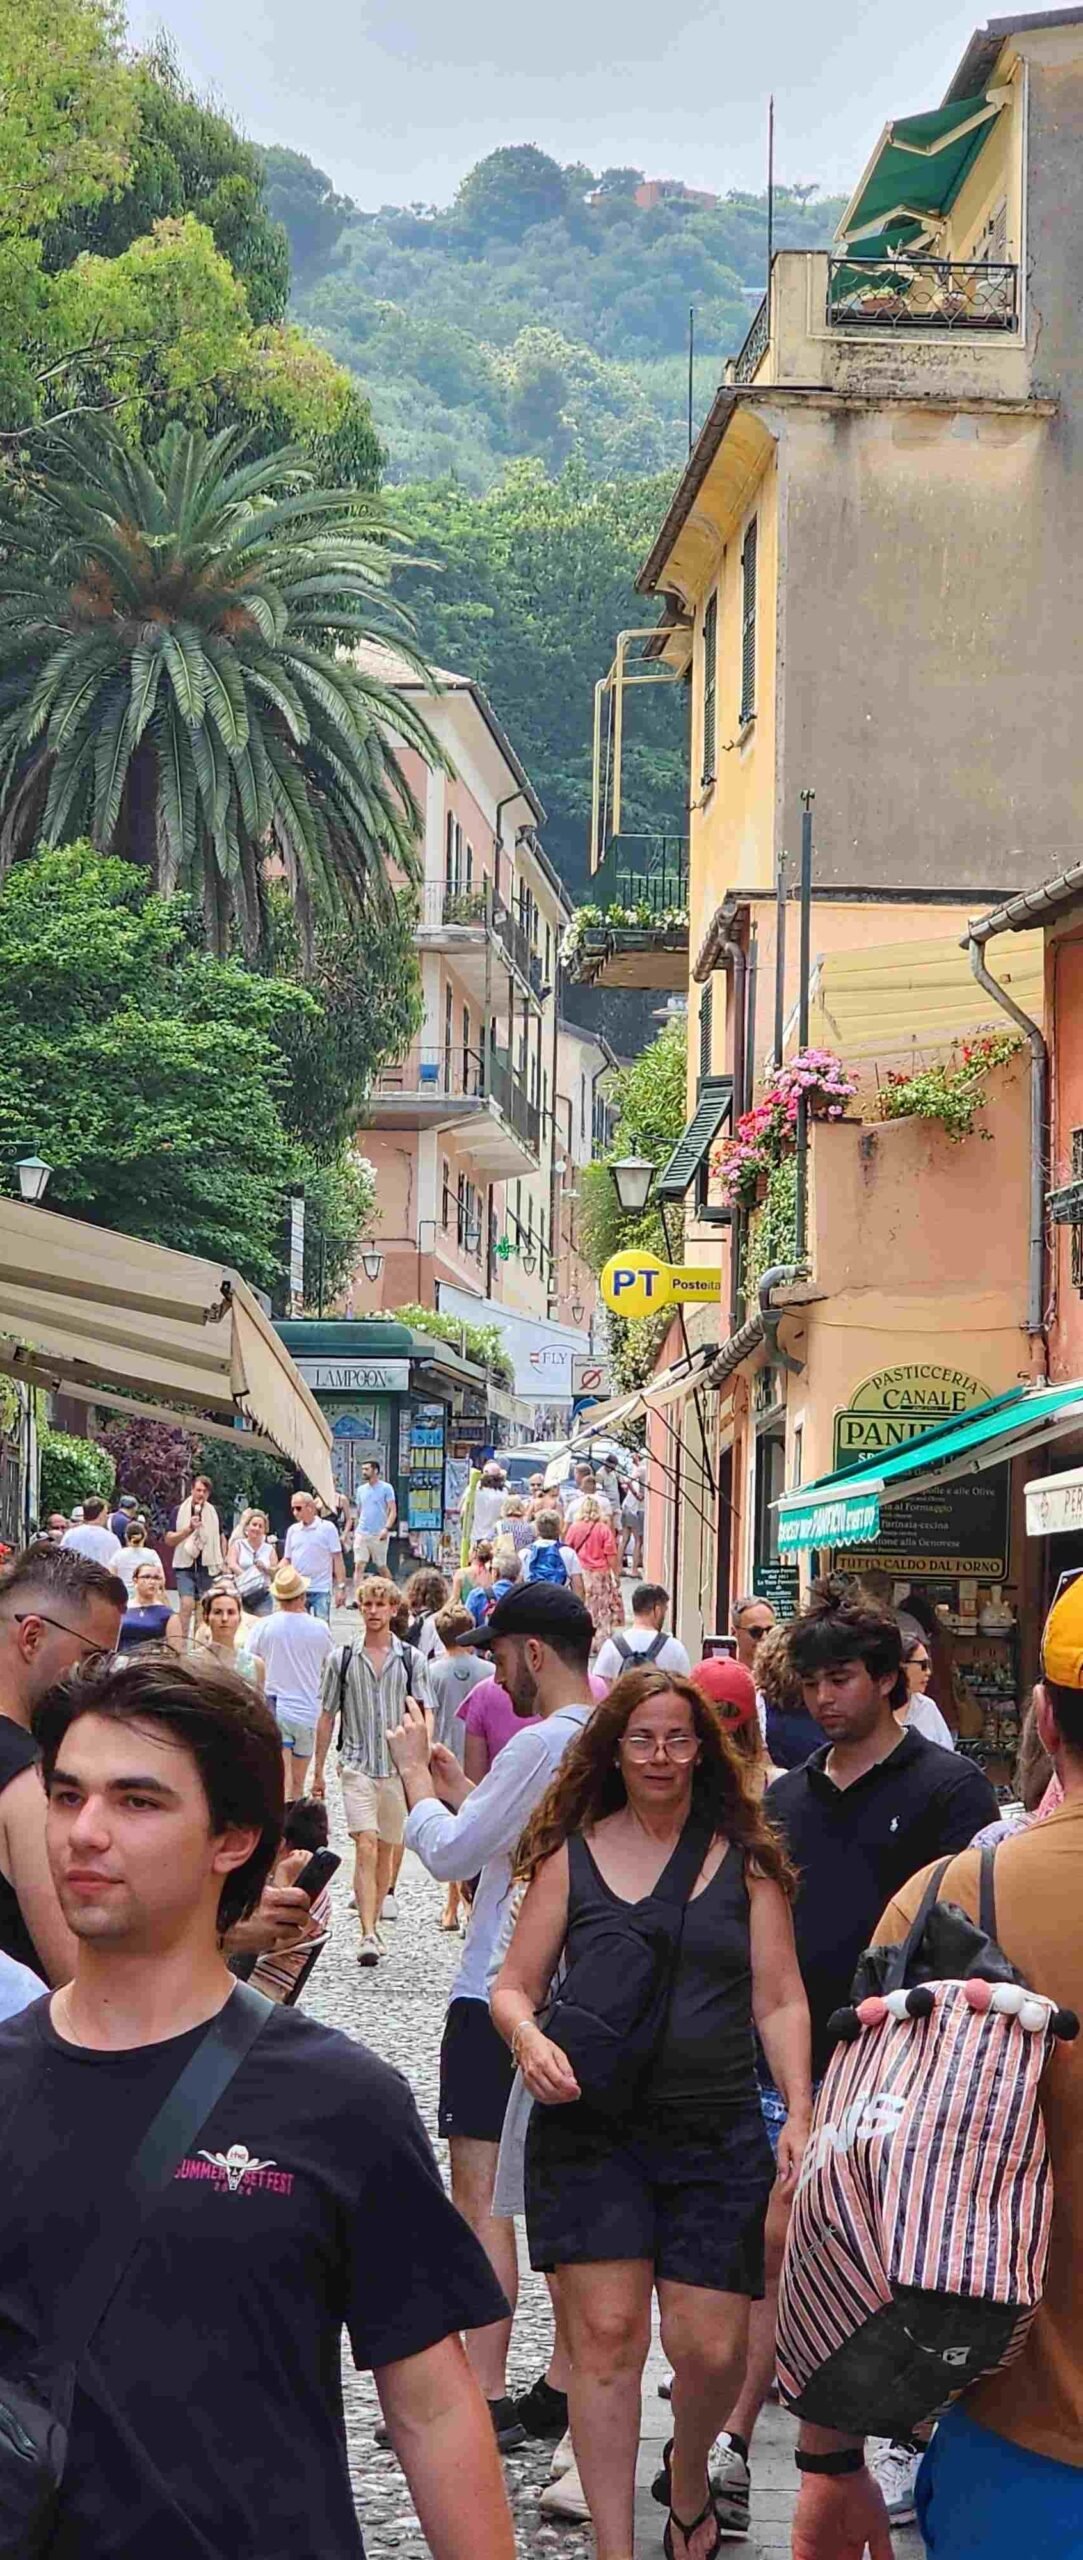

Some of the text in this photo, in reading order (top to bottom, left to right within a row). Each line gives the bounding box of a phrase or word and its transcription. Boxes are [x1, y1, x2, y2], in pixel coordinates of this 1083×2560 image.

[614, 1269, 659, 1297] PT
[542, 1352, 567, 1365] FLY
[316, 1368, 387, 1388] LAMPOON
[871, 1366, 978, 1395] PASTICCERIA
[883, 1389, 967, 1411] CANALE
[883, 1559, 926, 1571] CALDO
[929, 1560, 952, 1572] DAL
[954, 1561, 1000, 1573] FORNO
[266, 2172, 294, 2195] FEST
